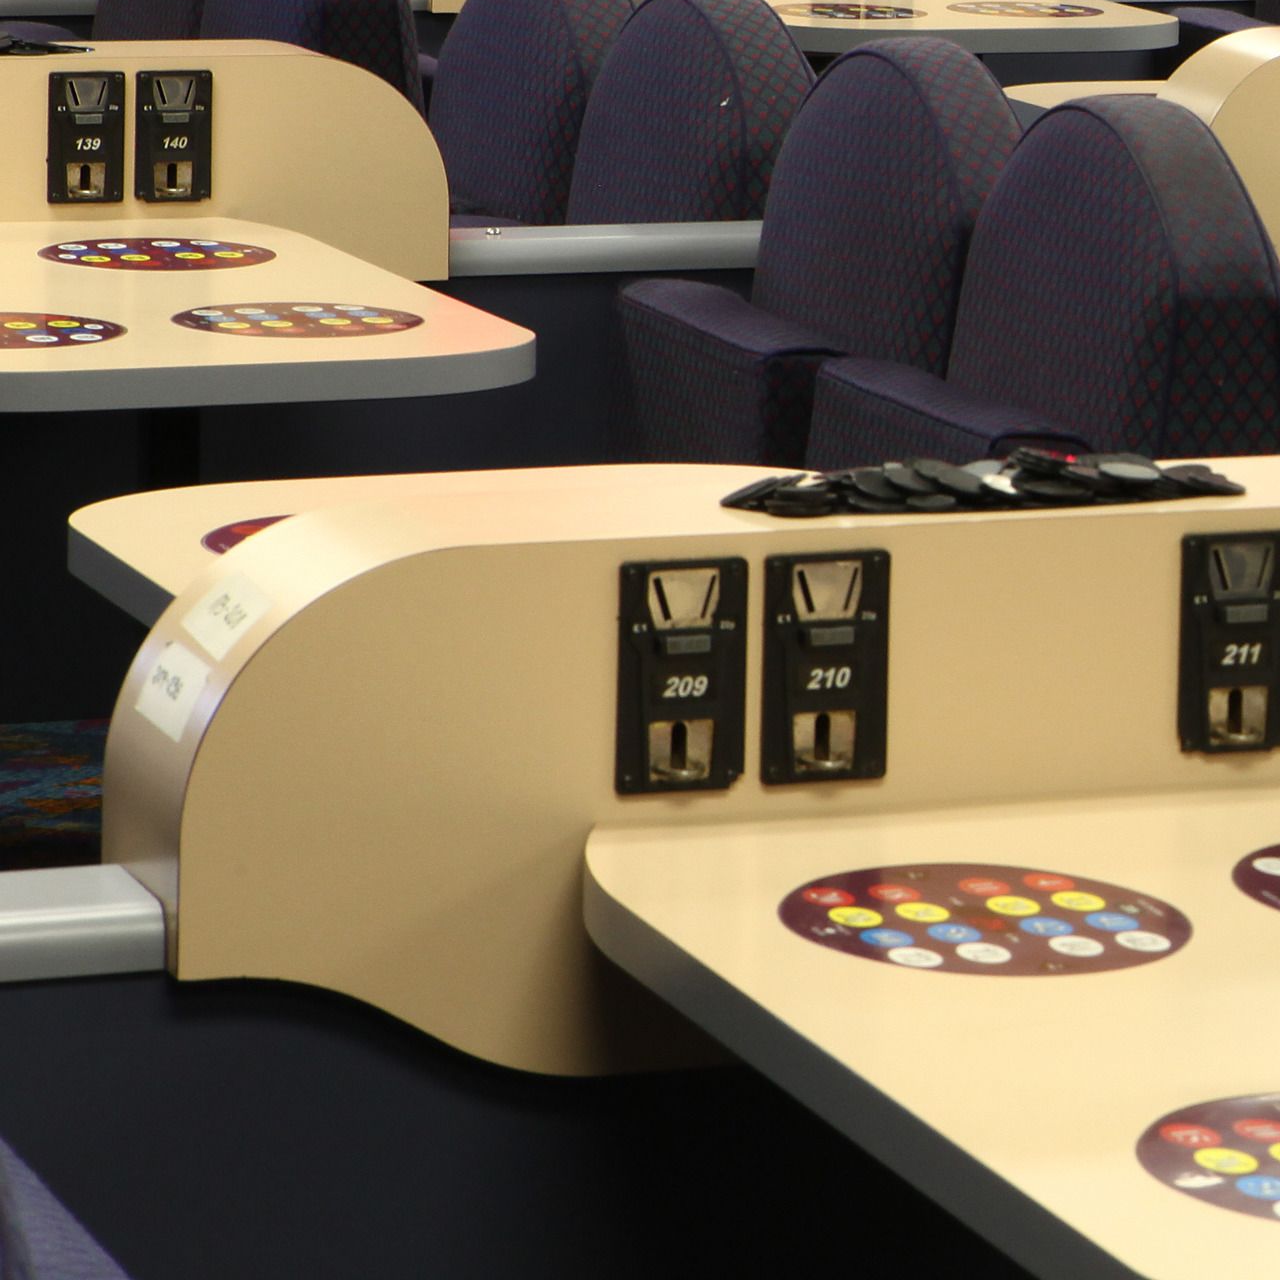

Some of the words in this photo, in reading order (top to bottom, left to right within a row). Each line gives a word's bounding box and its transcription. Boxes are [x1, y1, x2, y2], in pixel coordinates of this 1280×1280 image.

[75, 138, 101, 151] 139
[162, 136, 188, 149] 140
[1222, 643, 1262, 666] 211
[663, 676, 708, 698] 209
[807, 667, 851, 690] 210
